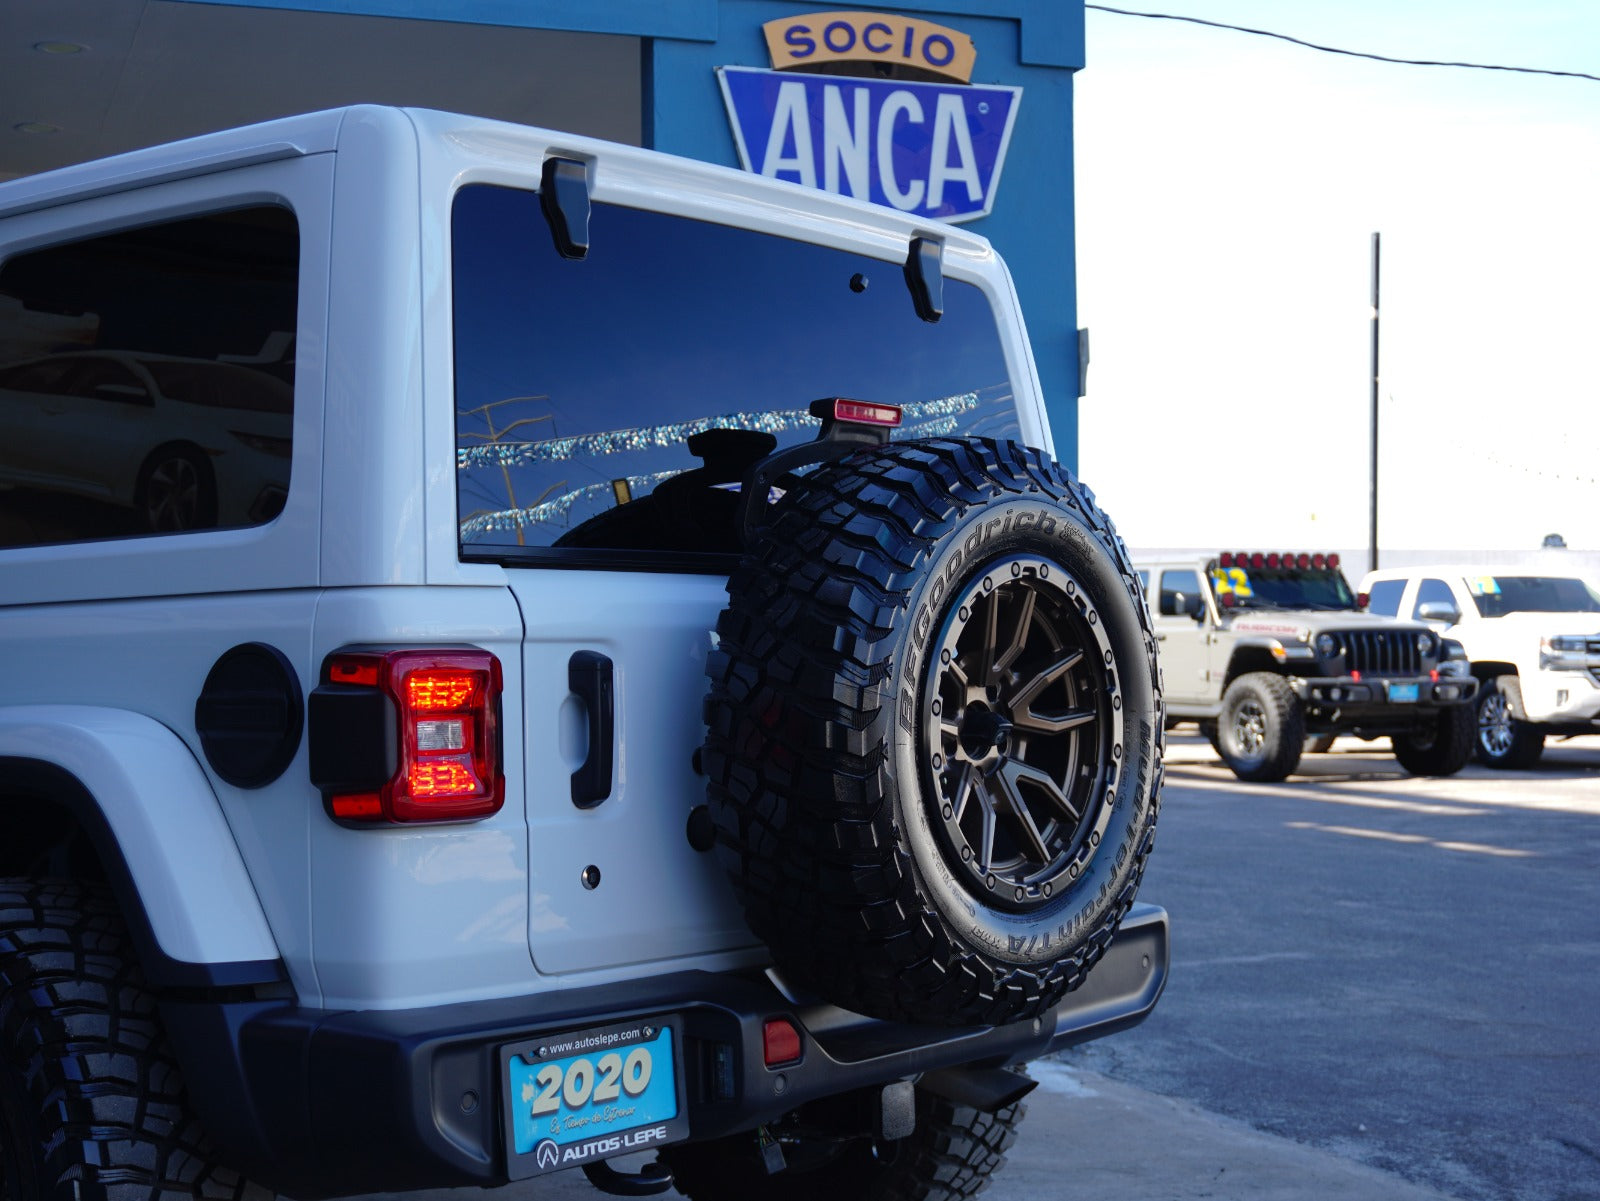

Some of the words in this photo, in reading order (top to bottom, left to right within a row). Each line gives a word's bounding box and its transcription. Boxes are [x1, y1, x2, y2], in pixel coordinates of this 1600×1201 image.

[784, 21, 956, 66] SOCIO
[761, 81, 984, 212] ANCA
[899, 508, 1058, 736] BFGoodrich
[549, 1027, 641, 1054] www.autoslepe.com
[531, 1046, 653, 1118] 2020
